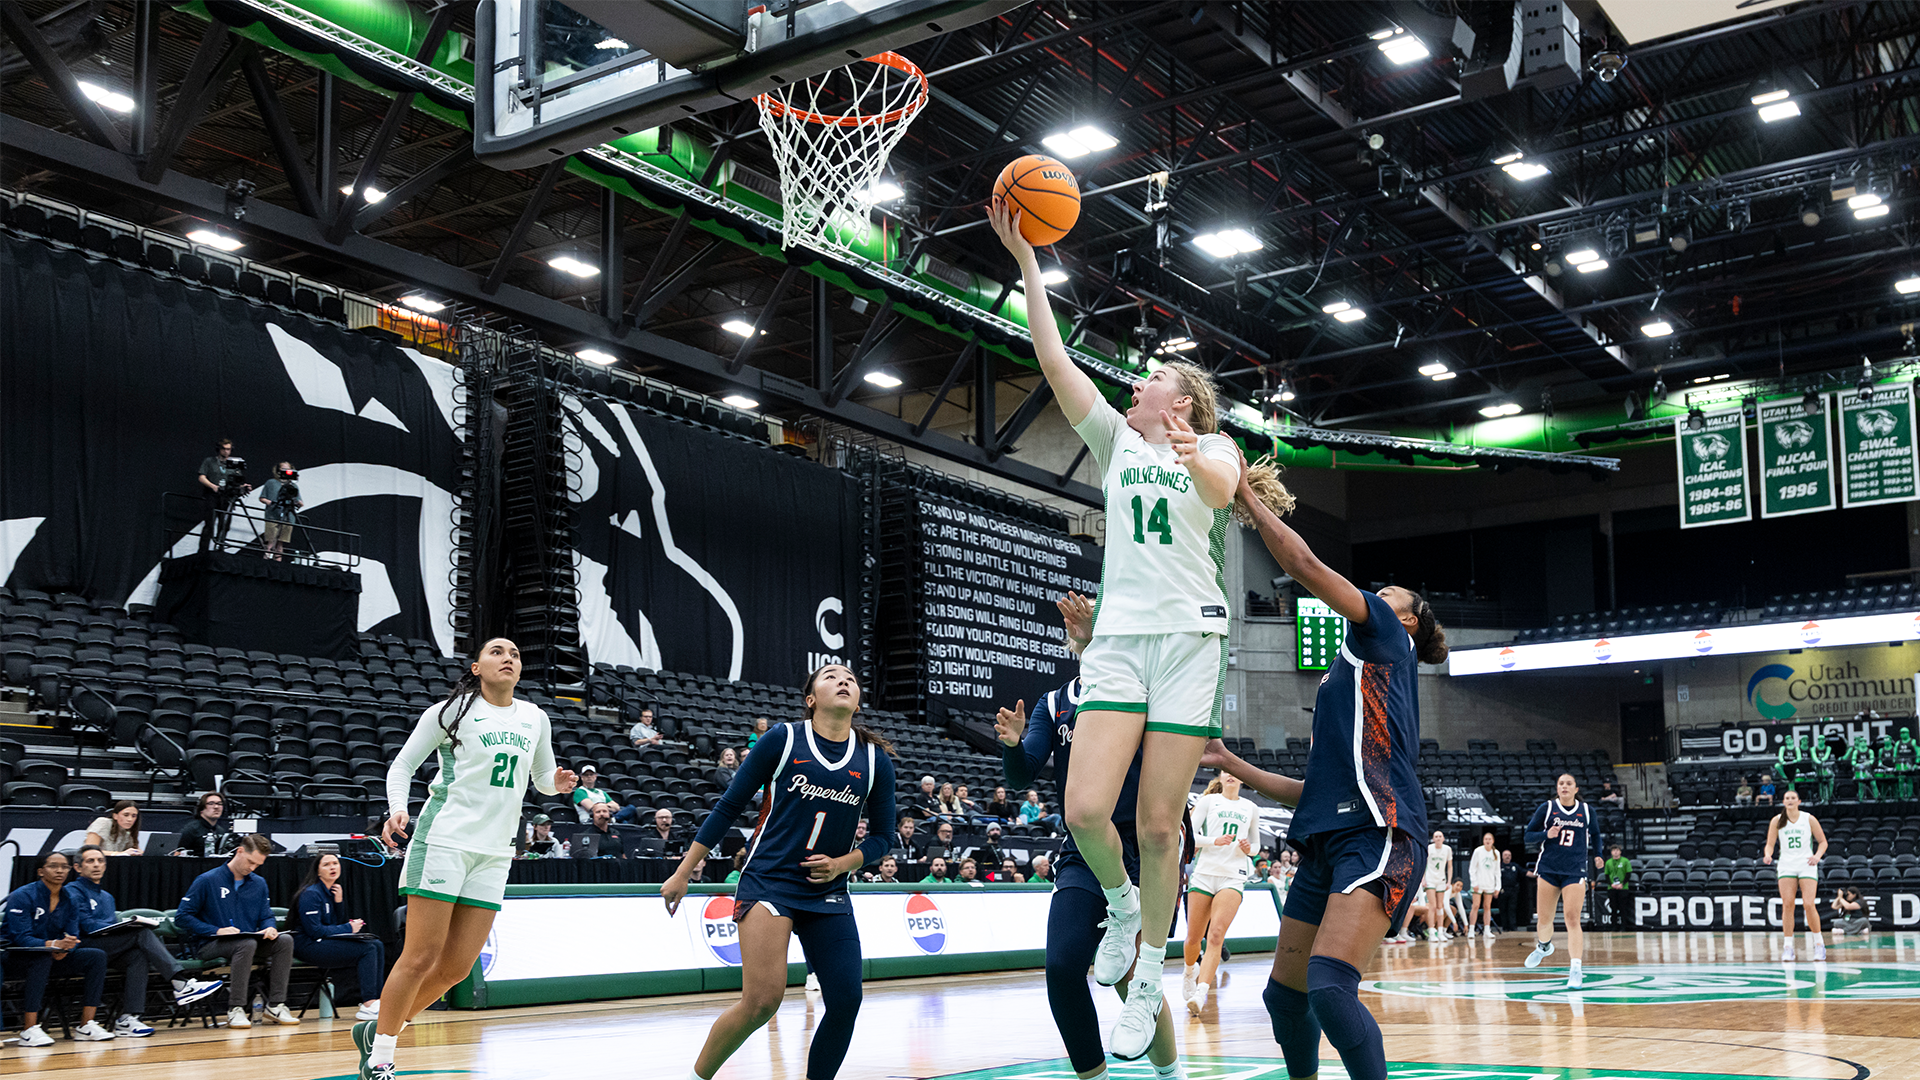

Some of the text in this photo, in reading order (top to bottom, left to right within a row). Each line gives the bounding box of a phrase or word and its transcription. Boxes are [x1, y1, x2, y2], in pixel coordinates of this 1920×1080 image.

[1844, 389, 1908, 406] UTA VALLEY
[1706, 414, 1740, 426] VALLEY
[1763, 406, 1788, 418] UTAH
[1860, 436, 1898, 451] SWAC
[1777, 450, 1816, 466] NJCAA
[1848, 446, 1912, 463] CHAMPIONS
[1699, 460, 1726, 473] ICAC
[1766, 460, 1828, 478] FINAL FOUR
[1120, 465, 1192, 493] WOLVERINES
[1685, 468, 1743, 485] CHAMPIONS
[1689, 484, 1742, 502] 1984-85
[1779, 481, 1818, 500] 1996
[1690, 499, 1743, 516] 1985-86
[919, 501, 1083, 556] STAND UP AND CHEER MIGHTY GREEN
[1131, 495, 1173, 545] 14
[922, 522, 1067, 569] WE ARE THE PROUD WOLVERINES
[923, 541, 963, 561] STRONG
[963, 547, 975, 563] IN
[975, 553, 1010, 573] BATTLE
[1010, 560, 1030, 578] TILL
[1029, 565, 1047, 582] THE
[1048, 571, 1073, 590] GAME
[1072, 576, 1082, 591] IS
[945, 564, 964, 581] THE
[965, 569, 1006, 590] VICTORY
[1005, 578, 1021, 594] WE
[1021, 582, 1046, 601] HAVE
[924, 582, 1036, 615] STAND UP AND SING UVU
[925, 602, 947, 618] OUR
[947, 606, 974, 622] SONG
[974, 610, 998, 627] WILL
[999, 615, 1021, 631] RING
[1021, 620, 1046, 637] LOUD
[1046, 625, 1065, 640] AND
[926, 622, 965, 640] FOLLOW
[965, 628, 992, 644] YOUR
[992, 632, 1029, 652] COLORS
[1029, 640, 1041, 653] BE
[1042, 643, 1071, 659] GREEN
[927, 642, 1056, 675] MIGHTY WOLVERINES OF UVU
[928, 660, 943, 674] GO
[971, 665, 993, 681] UVU
[1809, 661, 1861, 683] Utah
[928, 680, 943, 695] GO
[972, 685, 993, 700] UVU
[1812, 702, 1850, 715] CREDIT
[1852, 699, 1887, 714] UNION
[479, 732, 532, 753] WOLVERINES
[1723, 727, 1768, 754] GO
[490, 752, 518, 788] 21
[787, 774, 861, 806] Pepperdine
[1217, 811, 1248, 824] WOLVERINES
[1553, 817, 1584, 828] Pepperdine
[805, 811, 827, 850] 1
[1222, 822, 1238, 842] 10
[1559, 830, 1574, 847] 13
[1788, 837, 1801, 849] 25
[1435, 862, 1440, 870] 4
[706, 923, 738, 939] PEP
[908, 917, 944, 931] PEPSI
